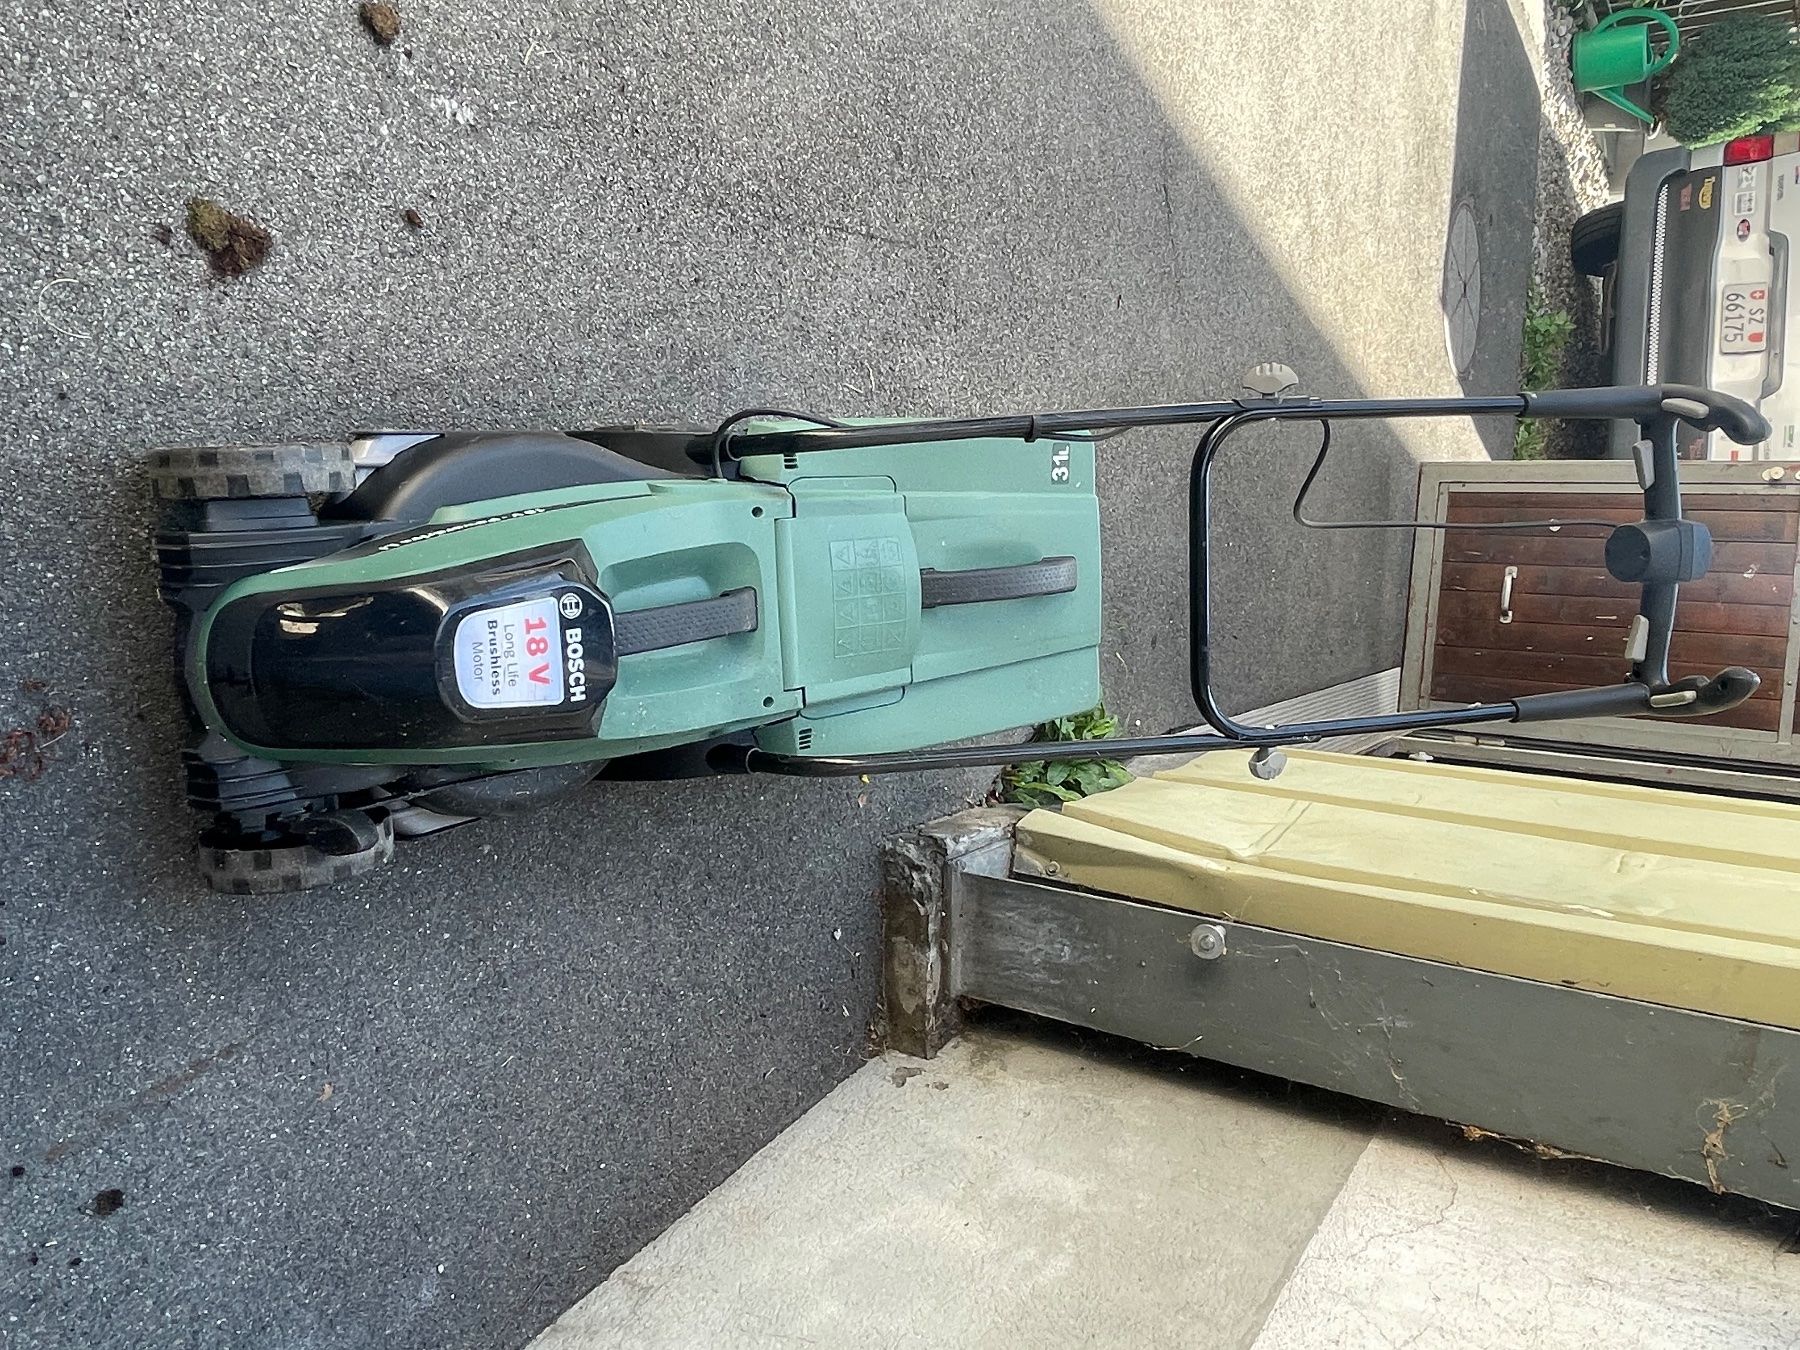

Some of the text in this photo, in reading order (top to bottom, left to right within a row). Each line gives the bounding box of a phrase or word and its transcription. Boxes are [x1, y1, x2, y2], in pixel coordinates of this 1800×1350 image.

[1724, 293, 1746, 342] 66175
[1748, 308, 1764, 324] SZ
[472, 641, 484, 682] Motor
[487, 619, 501, 696] Brushless
[503, 624, 519, 687] Long Life
[523, 617, 551, 685] 18 V
[565, 627, 587, 702] BOSCH
